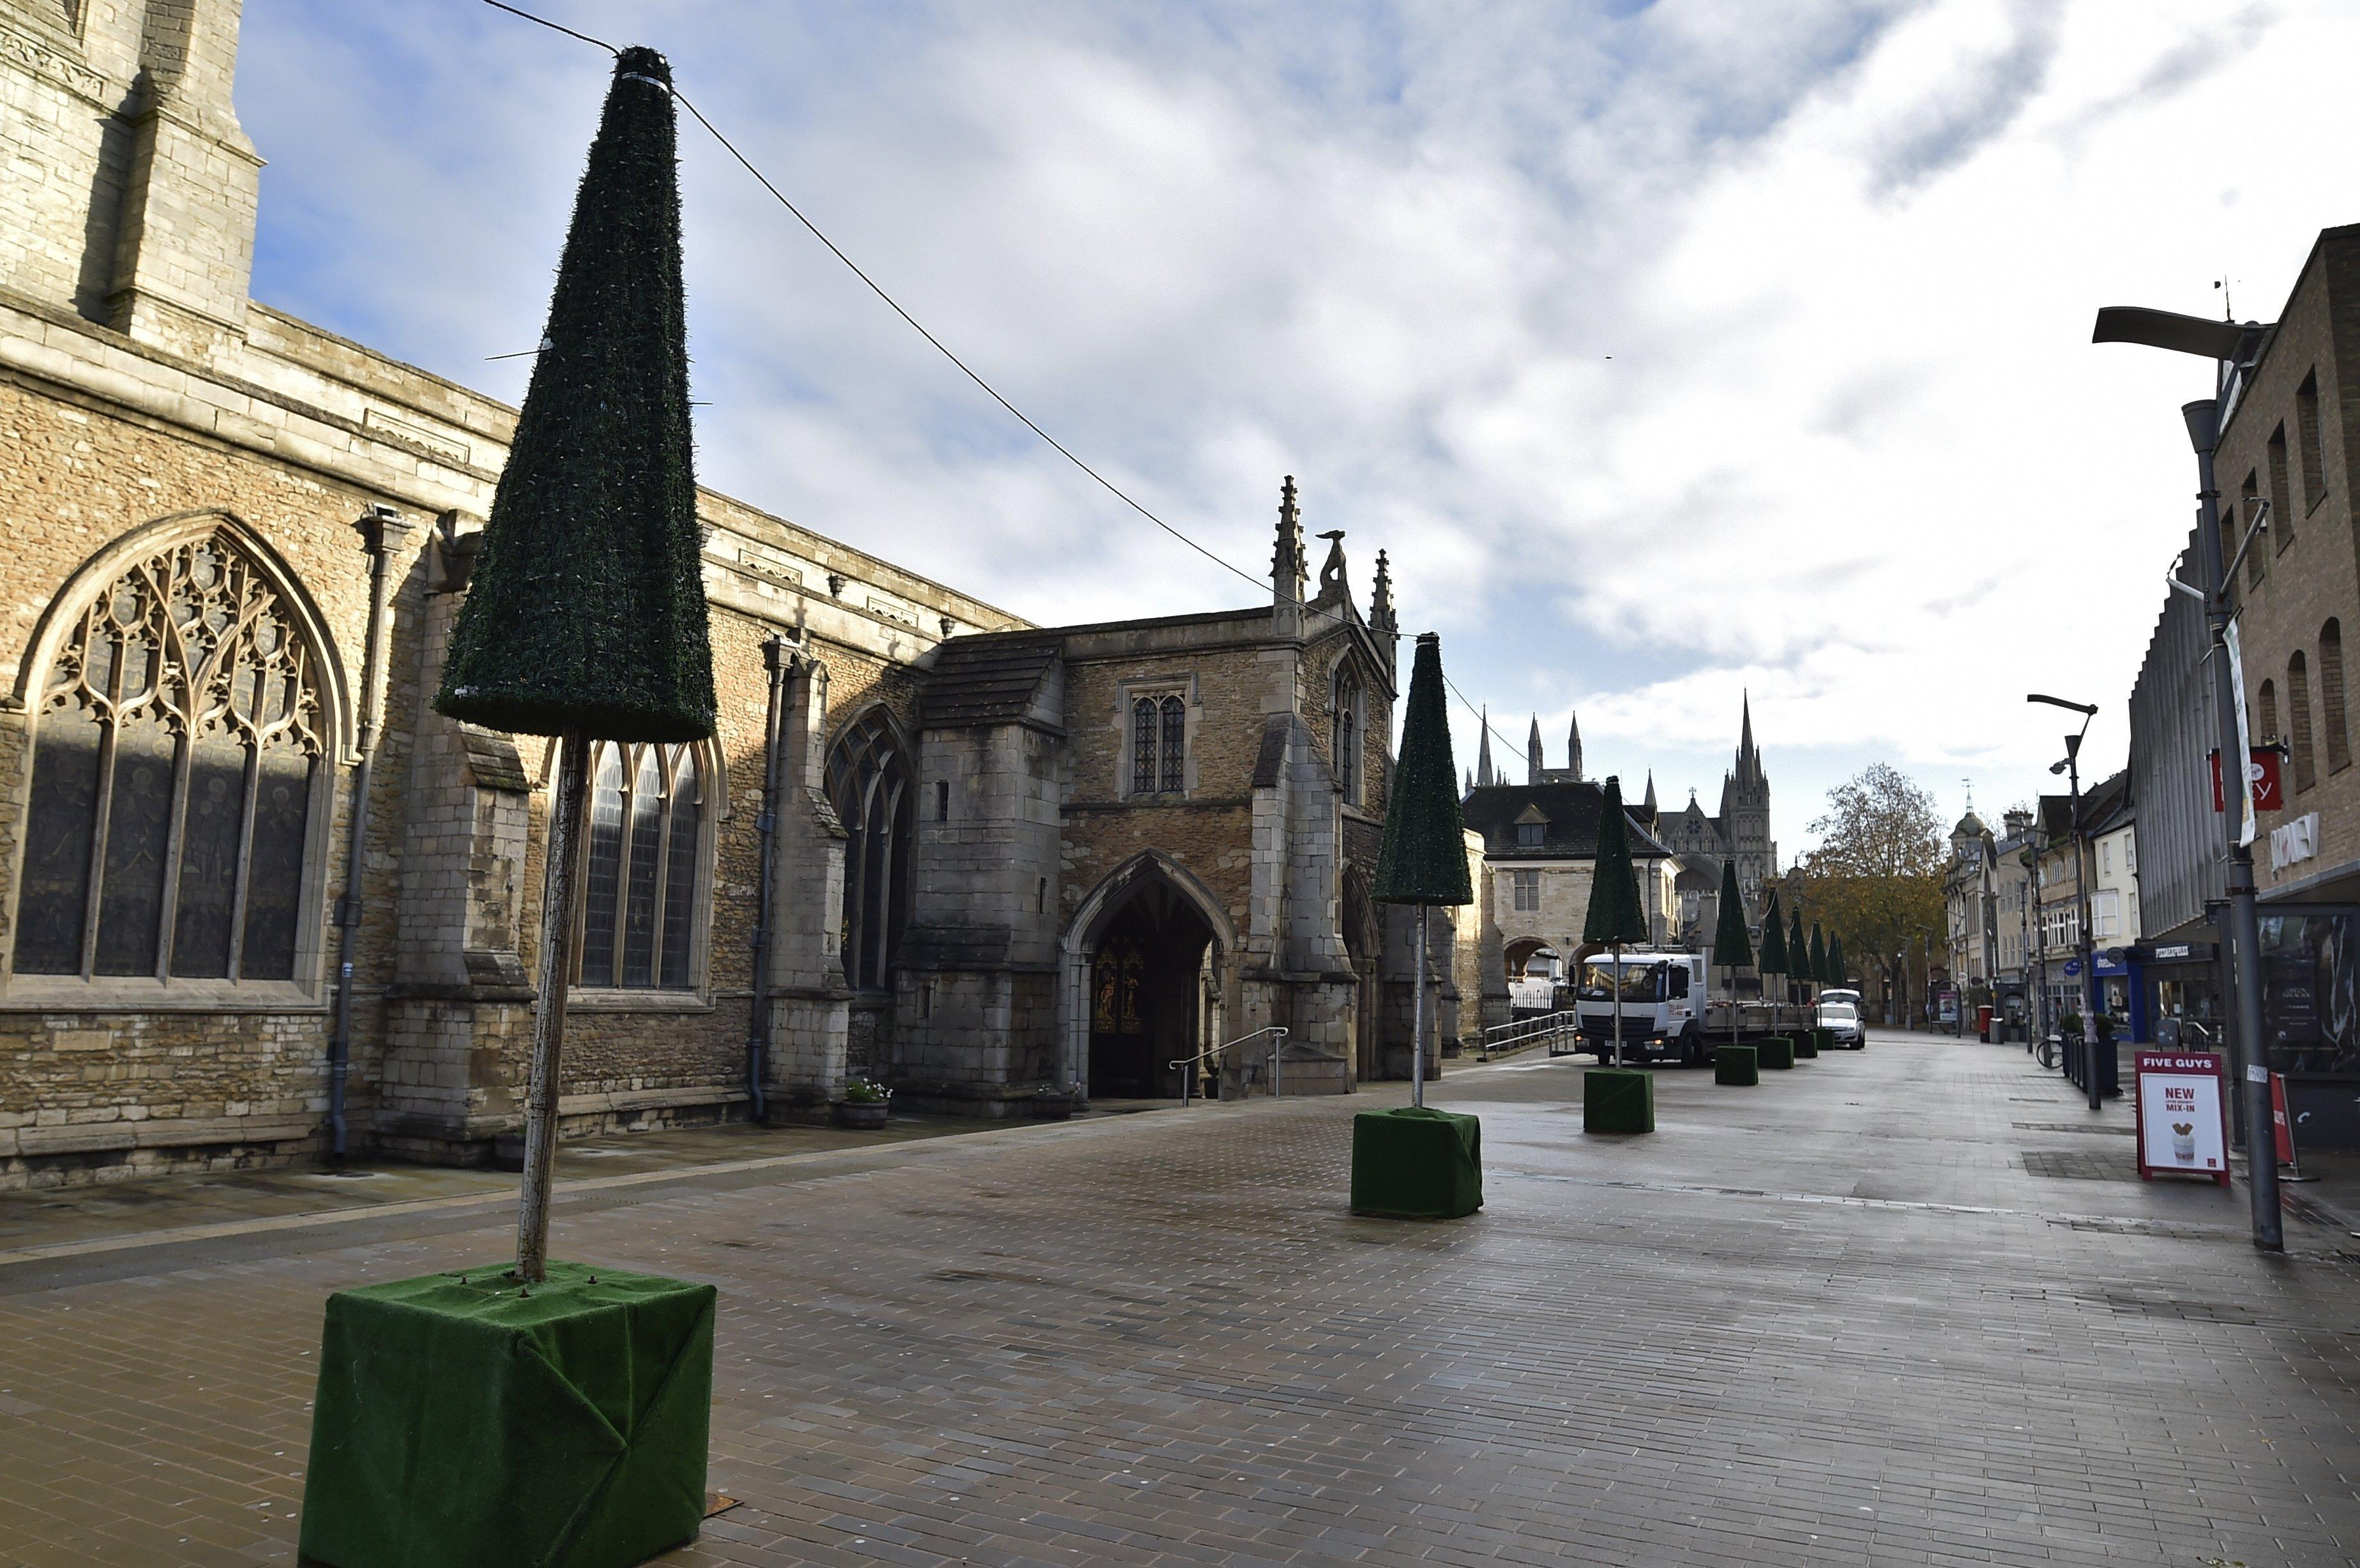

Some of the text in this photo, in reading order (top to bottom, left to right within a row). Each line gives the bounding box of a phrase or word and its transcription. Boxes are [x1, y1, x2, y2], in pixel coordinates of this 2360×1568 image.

[2144, 1058, 2212, 1068] FIVE GUYS
[2165, 1087, 2194, 1099] NEW
[2166, 1104, 2195, 1112] MIX-IN
